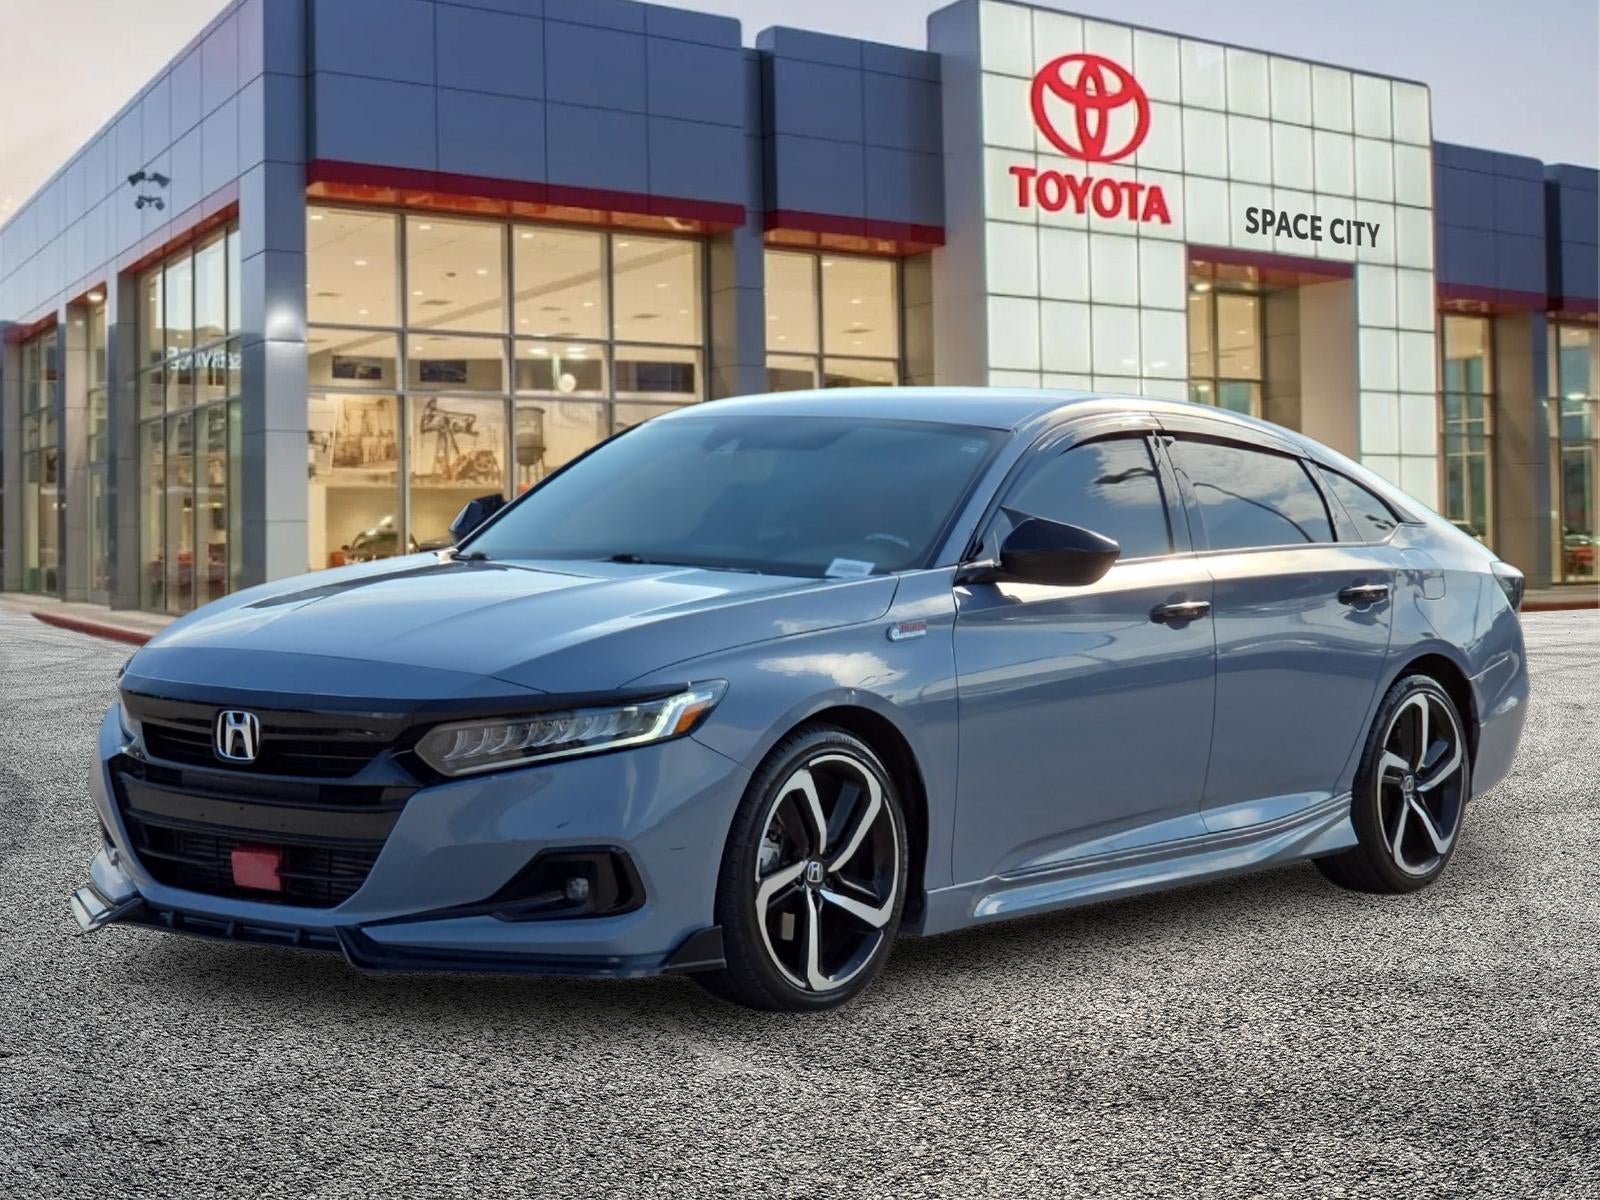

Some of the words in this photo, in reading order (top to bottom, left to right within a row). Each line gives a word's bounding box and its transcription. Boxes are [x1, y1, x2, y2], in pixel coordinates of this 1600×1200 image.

[1009, 166, 1171, 225] TOYOTA
[1245, 206, 1323, 242] SPACE
[1329, 217, 1381, 248] CITY
